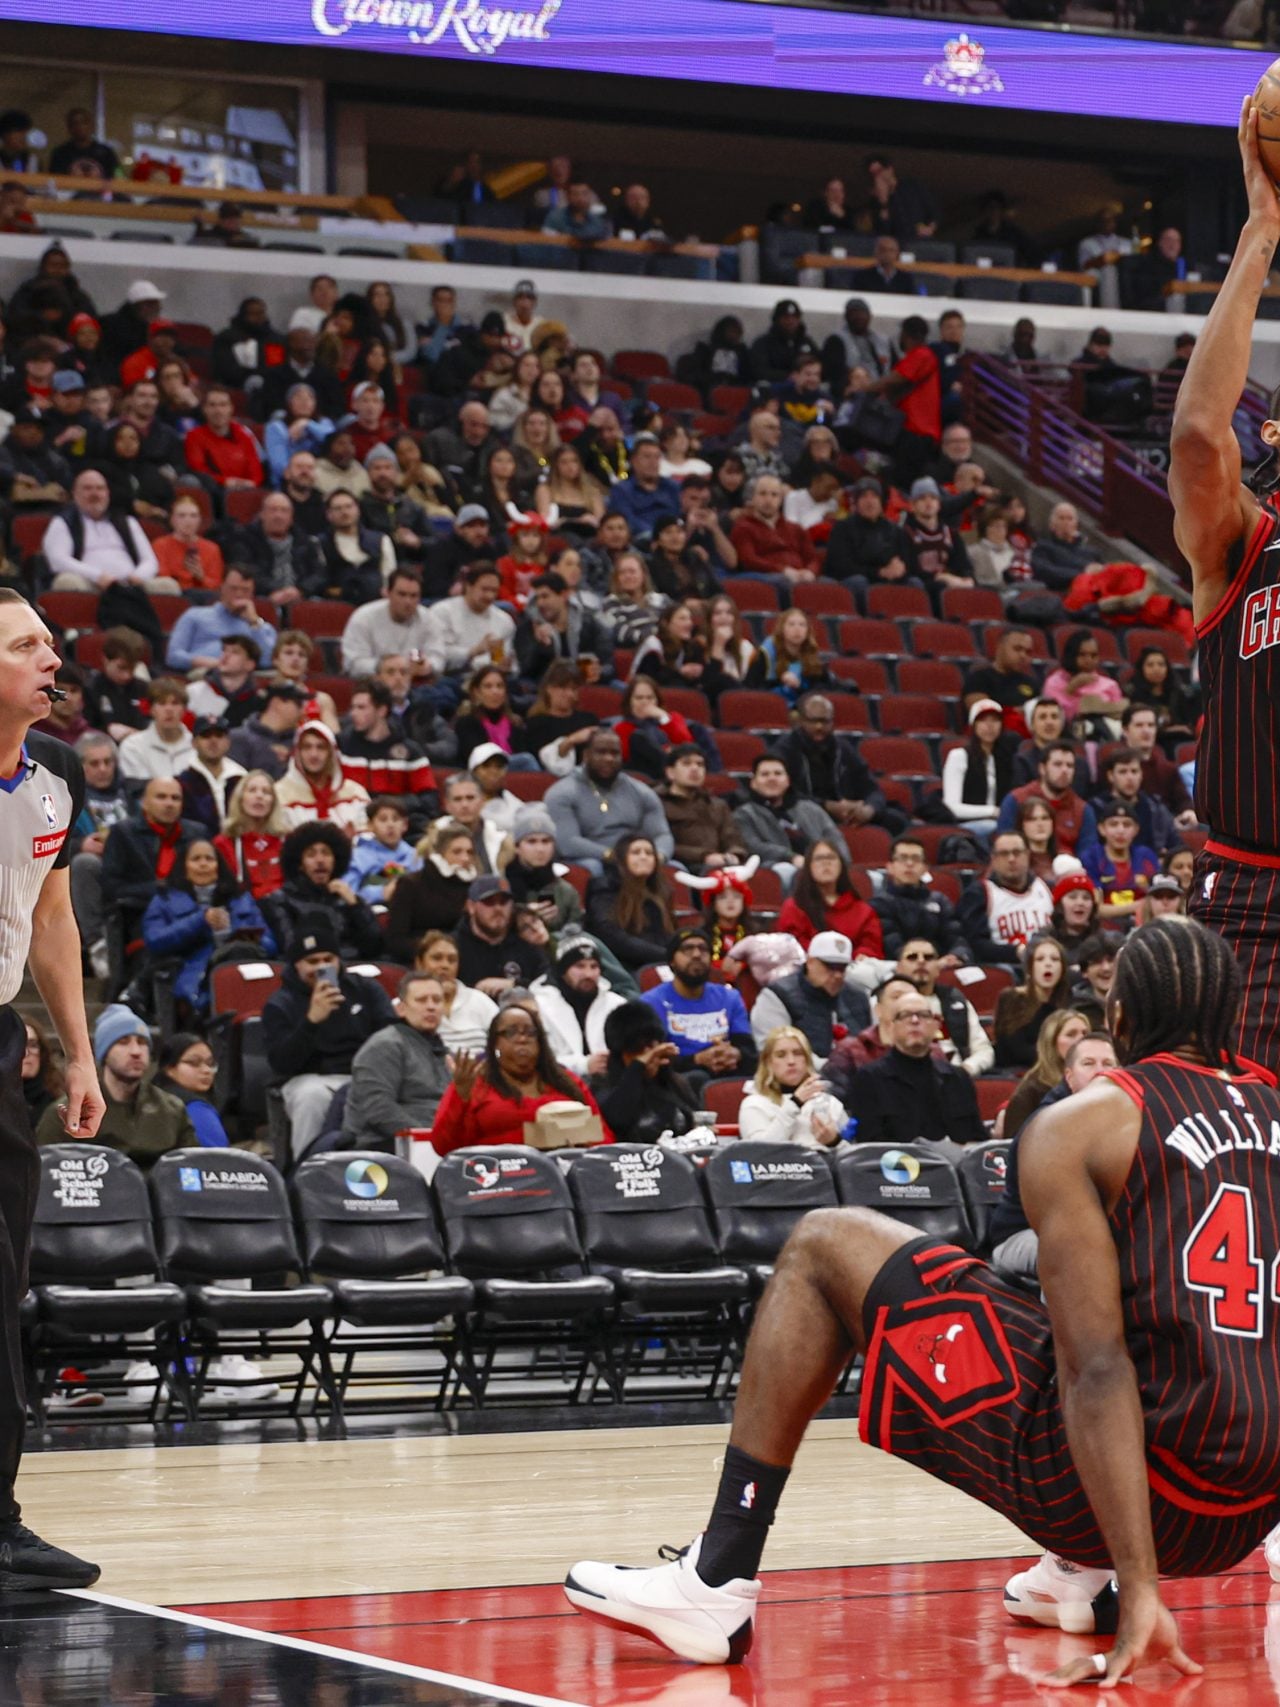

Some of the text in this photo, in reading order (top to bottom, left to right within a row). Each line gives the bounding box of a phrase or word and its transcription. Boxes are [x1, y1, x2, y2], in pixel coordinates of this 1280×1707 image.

[311, 0, 563, 54] Crown Royal
[34, 836, 65, 854] Emira
[751, 1162, 814, 1174] LA RABIDA
[202, 1171, 269, 1185] LA RABIDA
